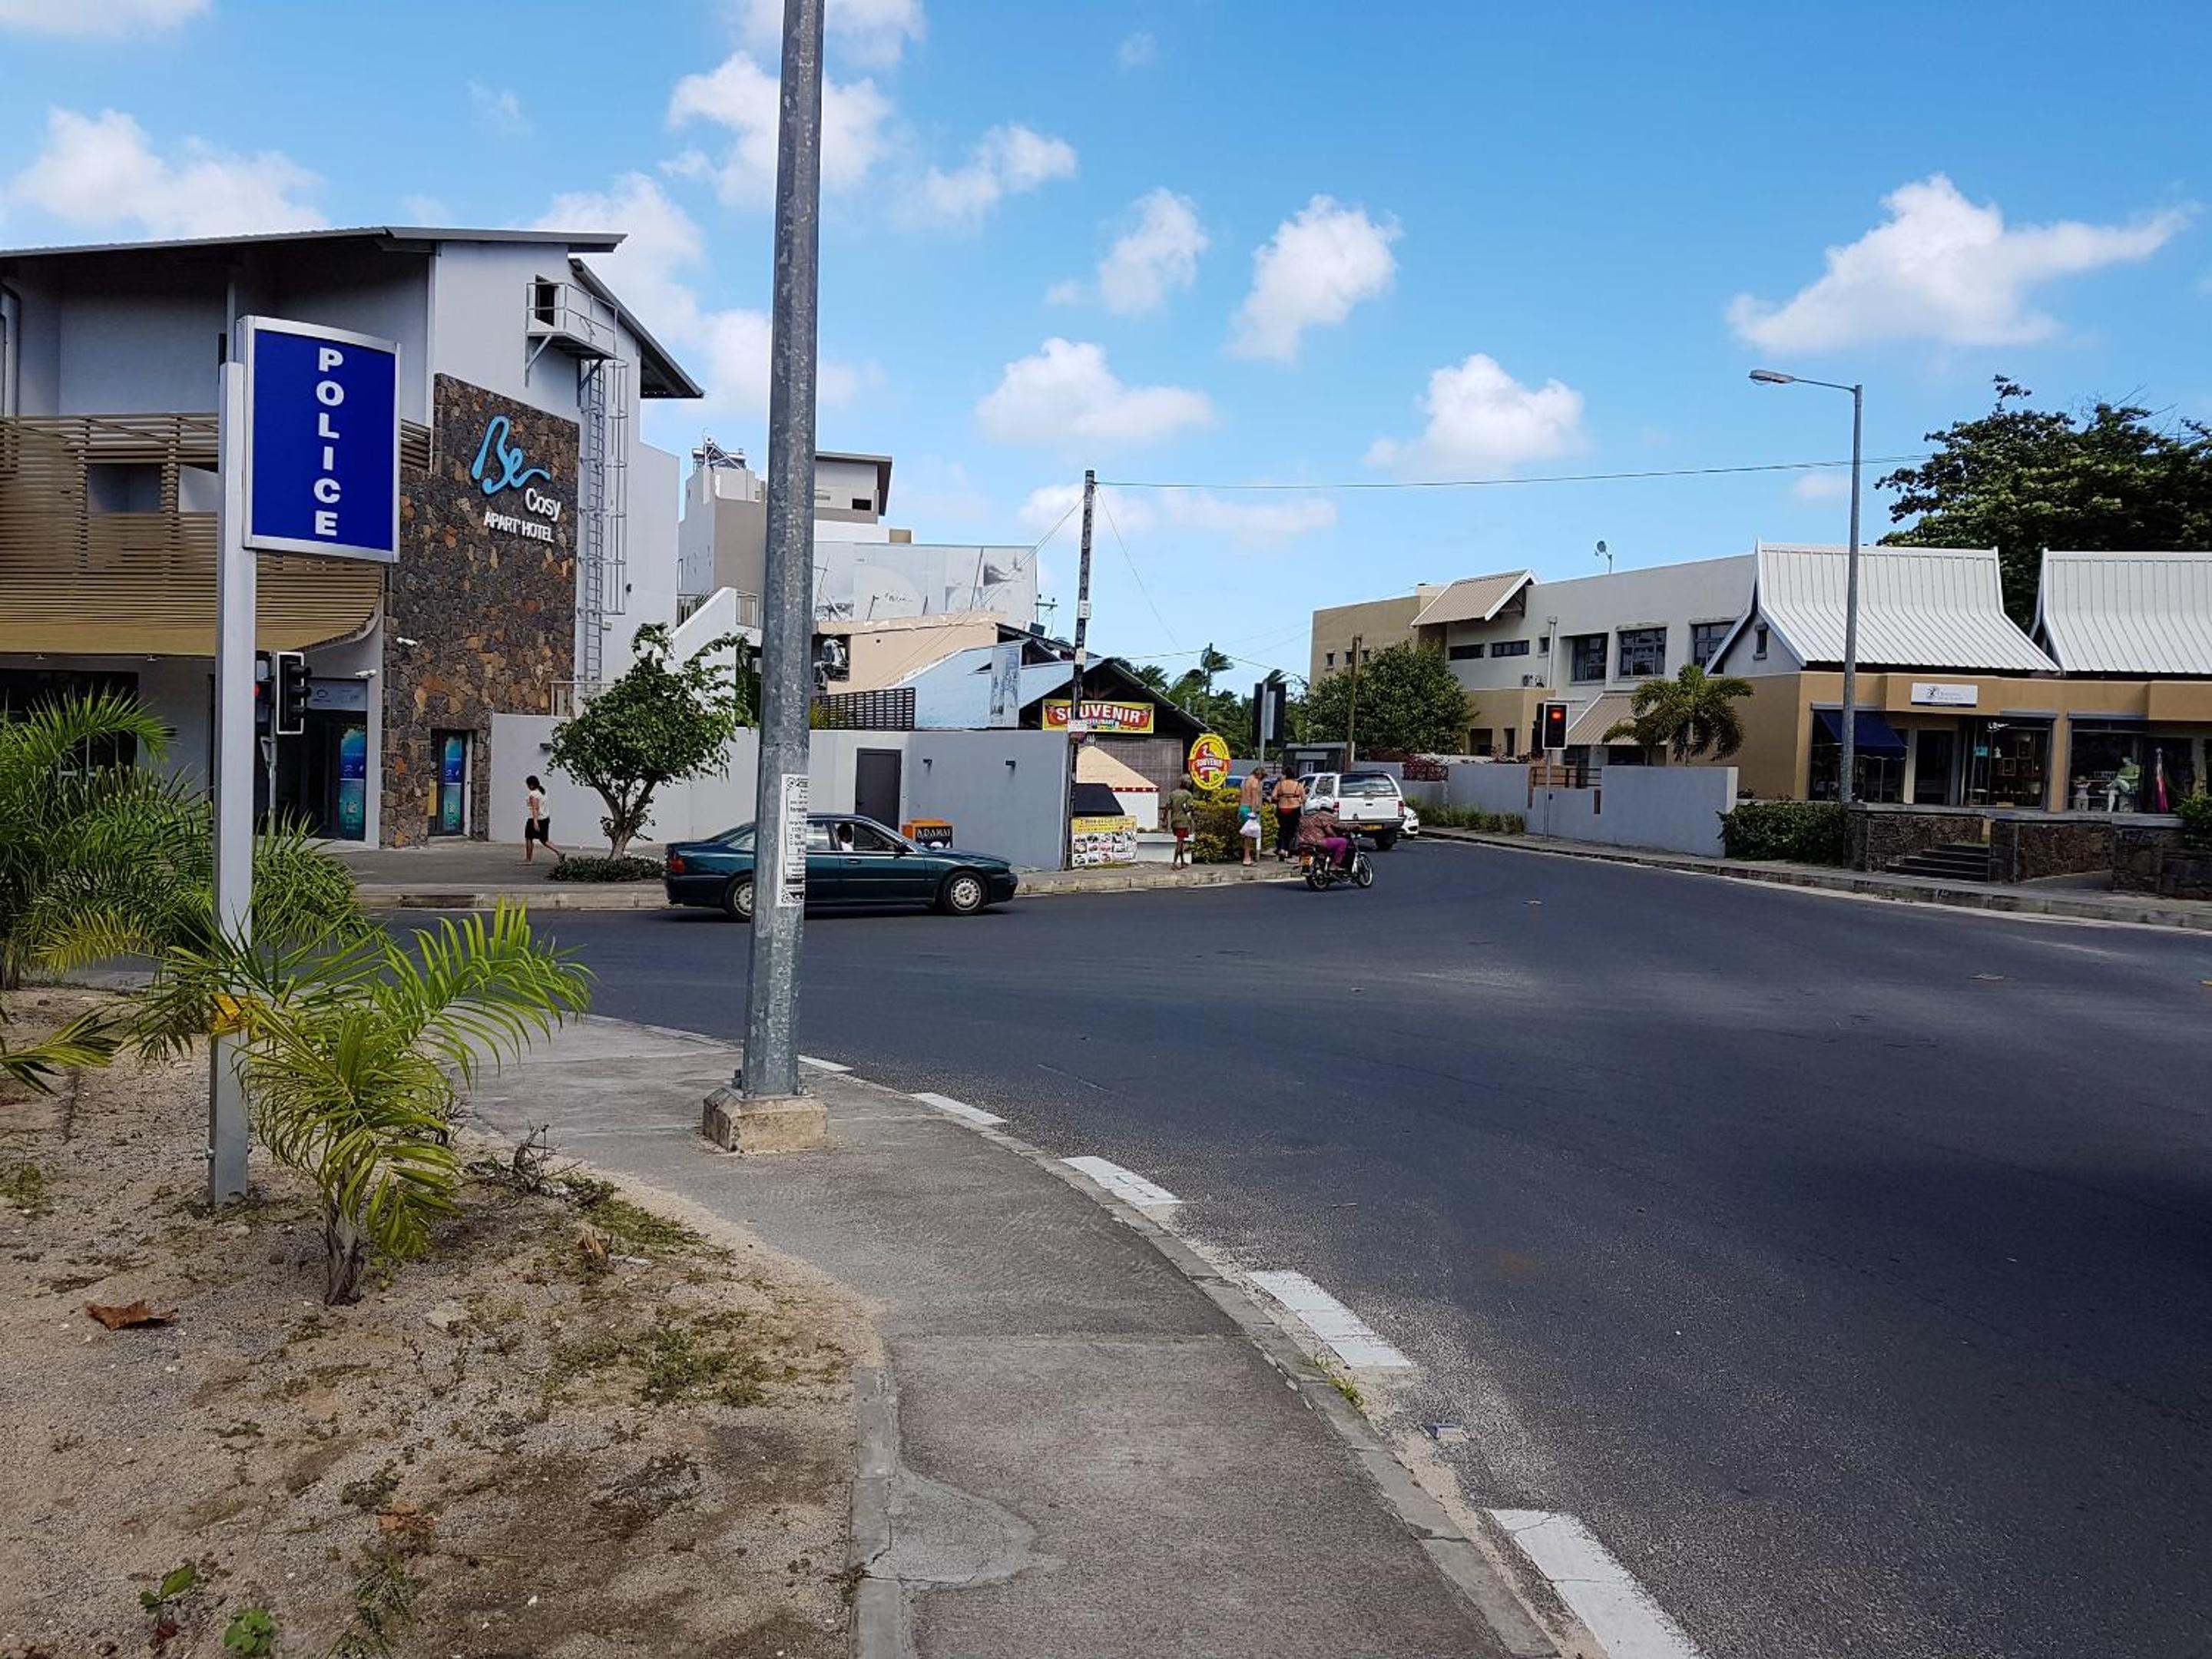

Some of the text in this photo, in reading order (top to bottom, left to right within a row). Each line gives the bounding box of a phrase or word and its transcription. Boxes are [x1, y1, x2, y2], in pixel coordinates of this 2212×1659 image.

[314, 346, 345, 536] POLICE
[471, 416, 551, 495] Be
[521, 520, 555, 543] HOTEL
[525, 487, 561, 522] Cosy
